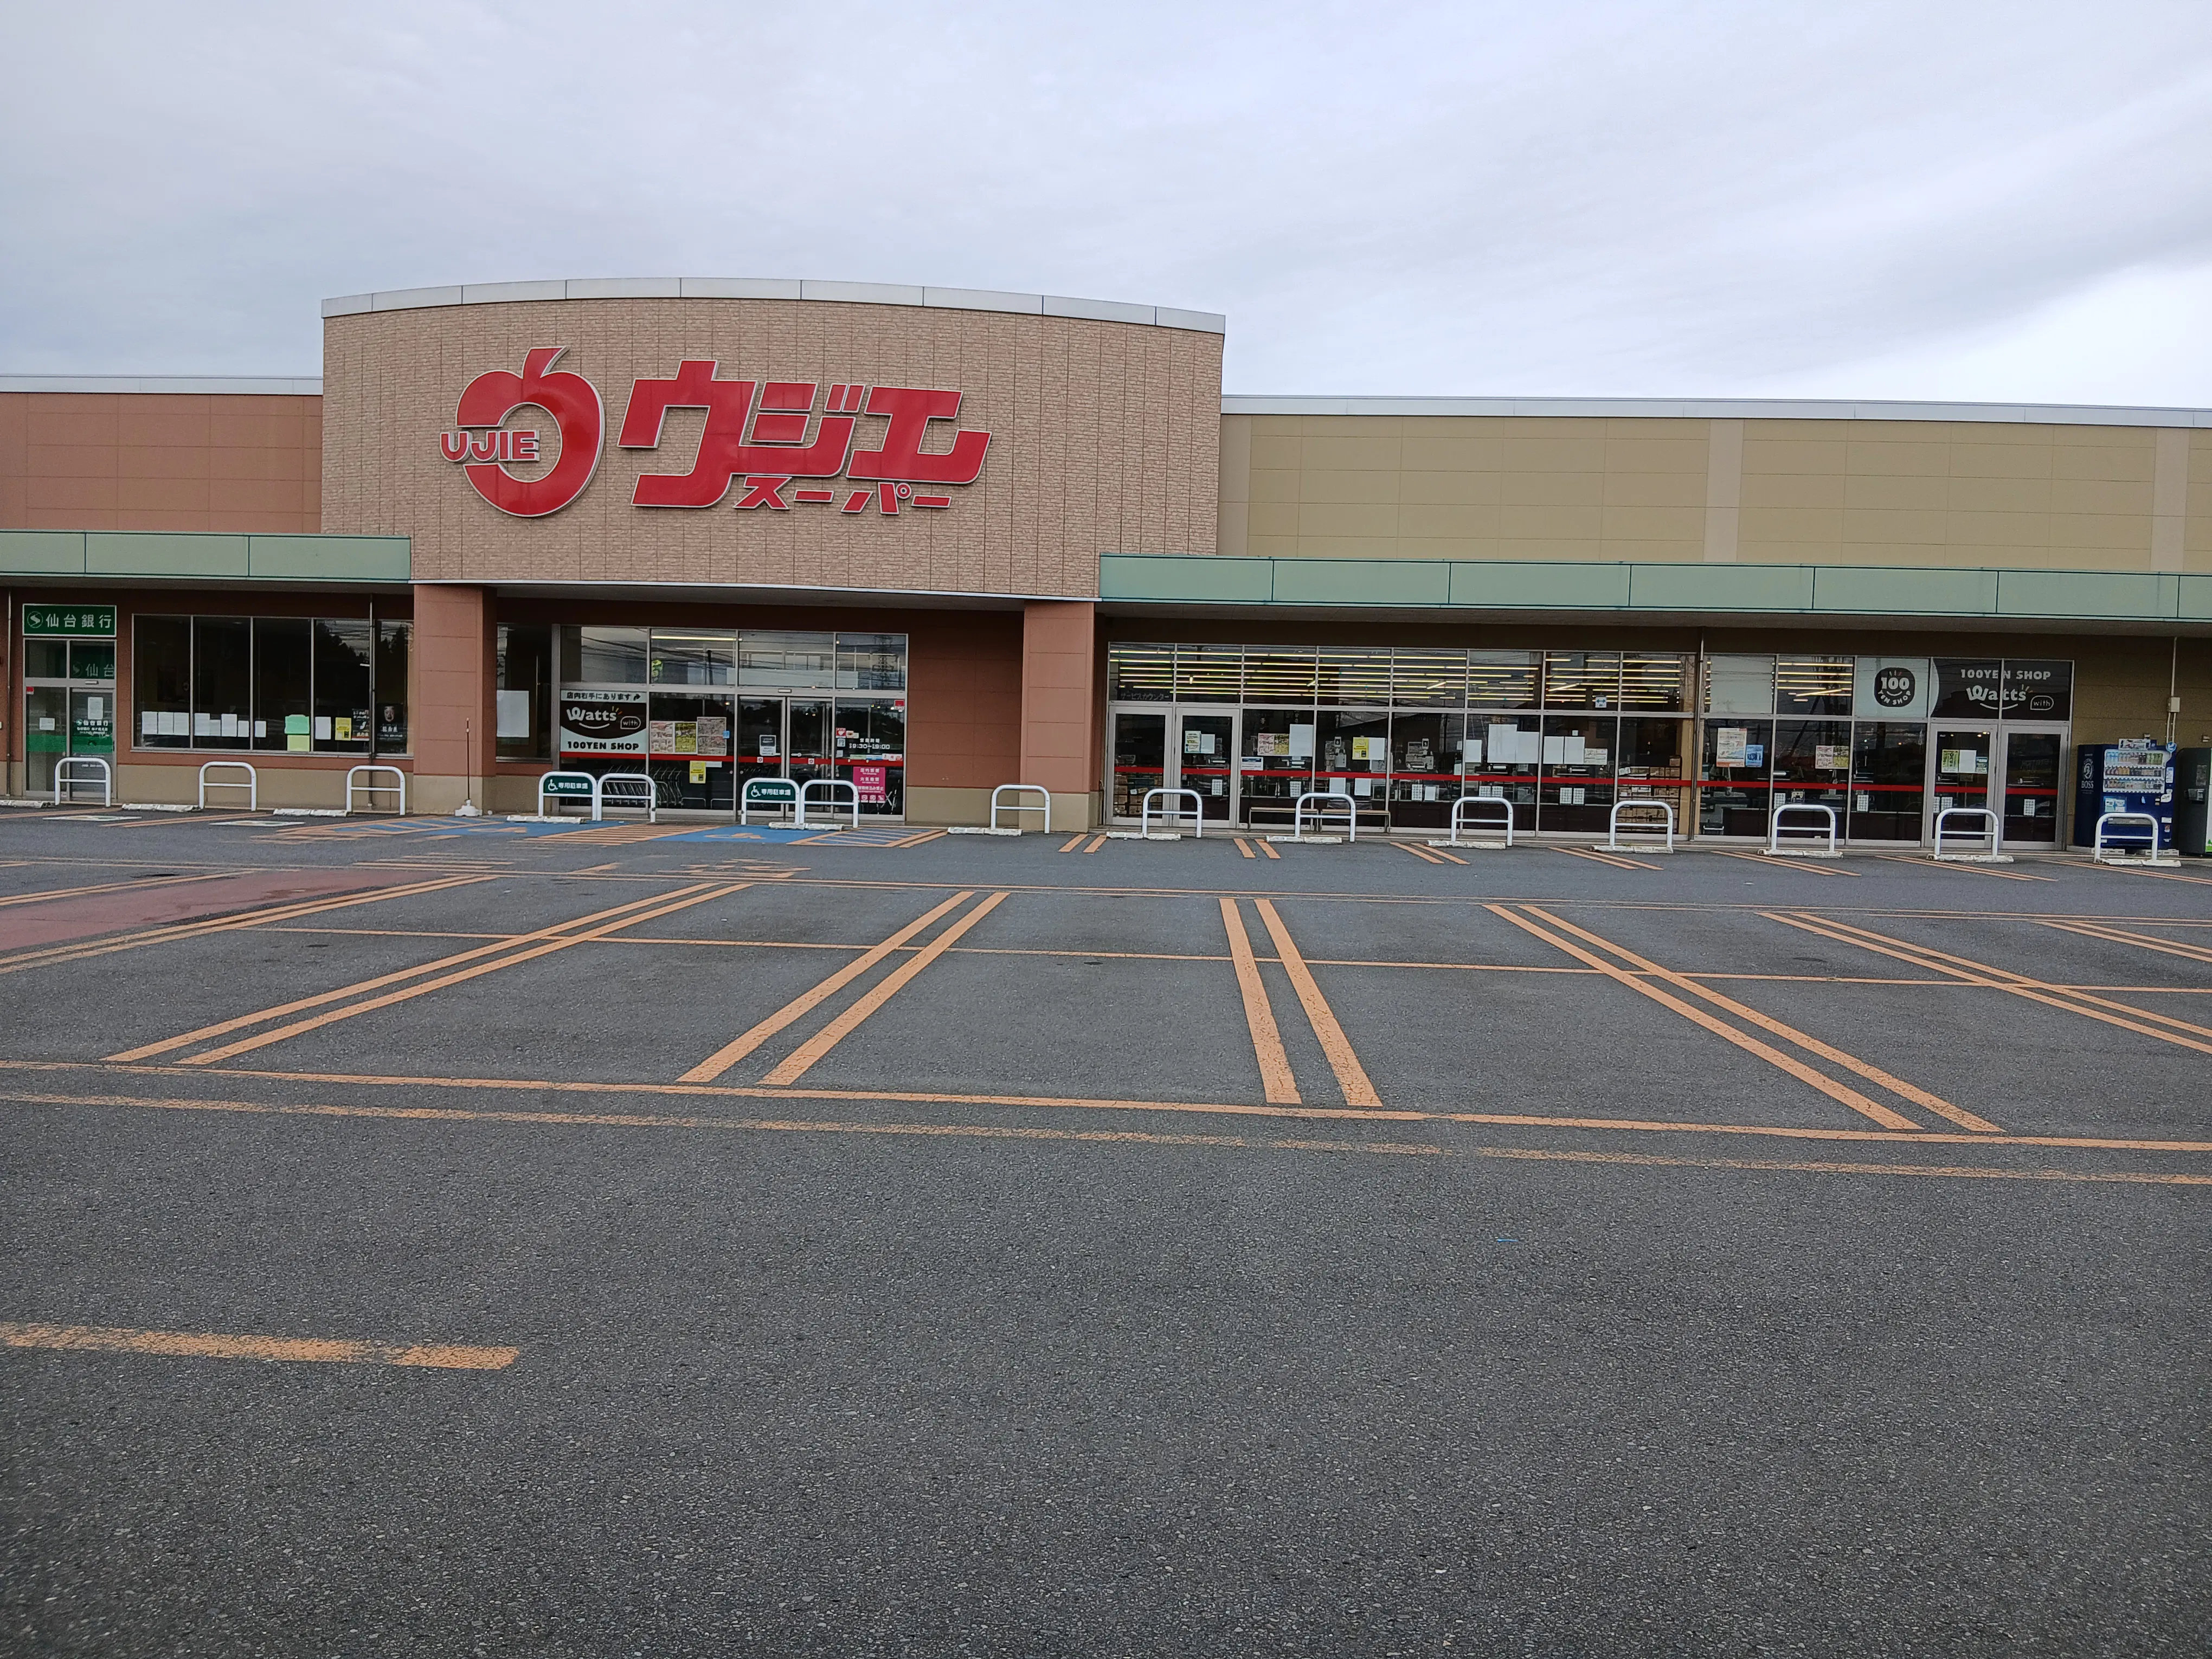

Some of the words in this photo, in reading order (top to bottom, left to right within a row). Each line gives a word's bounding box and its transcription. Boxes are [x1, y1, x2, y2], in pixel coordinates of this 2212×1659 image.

[618, 359, 992, 508] ウジエ
[440, 429, 540, 462] UJIE
[733, 475, 952, 515] スーパー
[46, 613, 112, 628] 仙台銀行
[1960, 669, 2011, 679] 100YEN
[2016, 670, 2051, 680] SHOP
[1881, 677, 1909, 690] 100
[567, 691, 631, 700] 店内右手にあります
[1892, 690, 1911, 705] SHOP
[1966, 685, 2027, 701] Watts
[566, 706, 617, 721] Watts
[568, 741, 607, 750] 100YEN
[610, 742, 639, 750] SHOP
[2081, 780, 2094, 789] BOSS
